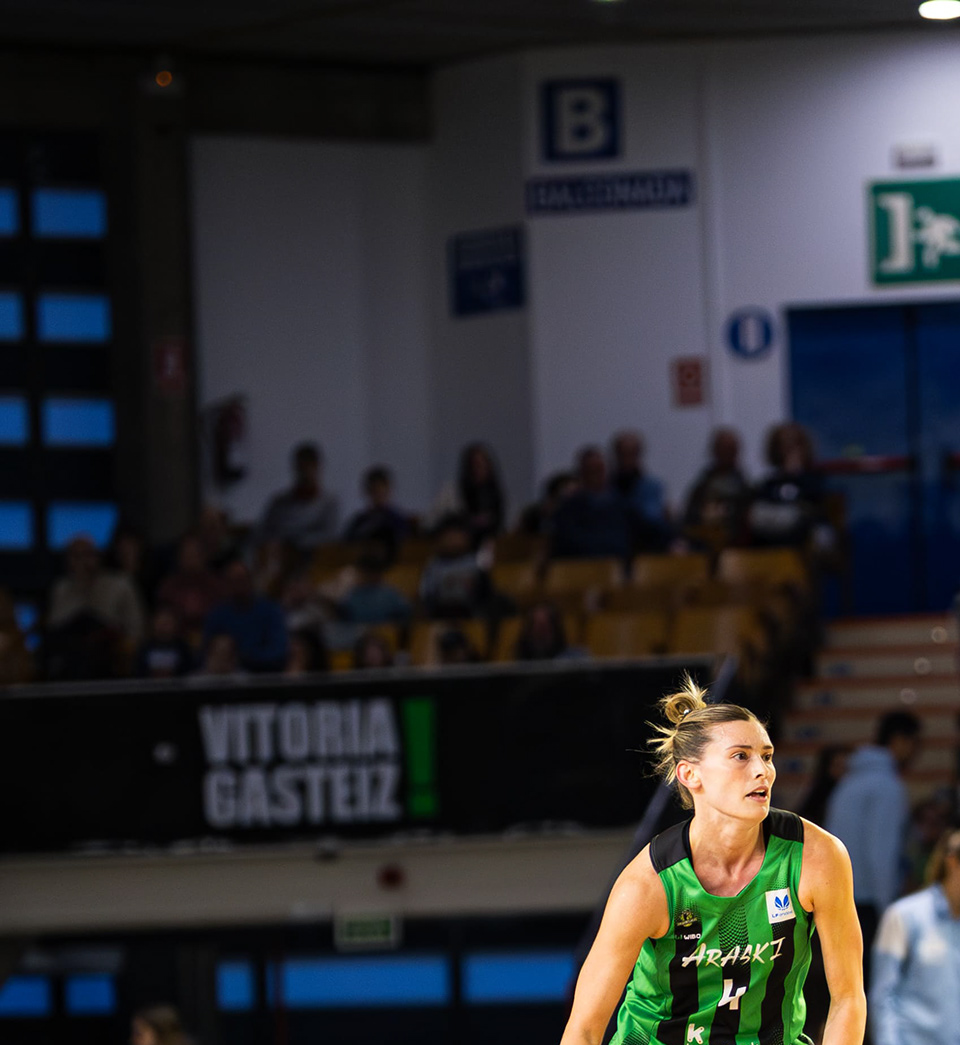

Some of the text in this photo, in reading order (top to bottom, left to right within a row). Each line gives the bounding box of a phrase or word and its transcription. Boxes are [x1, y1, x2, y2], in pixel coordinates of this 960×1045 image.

[553, 88, 606, 154] B
[199, 699, 399, 763] VITORIA
[204, 765, 401, 828] GASTEIZ
[681, 937, 786, 968] ARASKI
[717, 979, 747, 1010] 4
